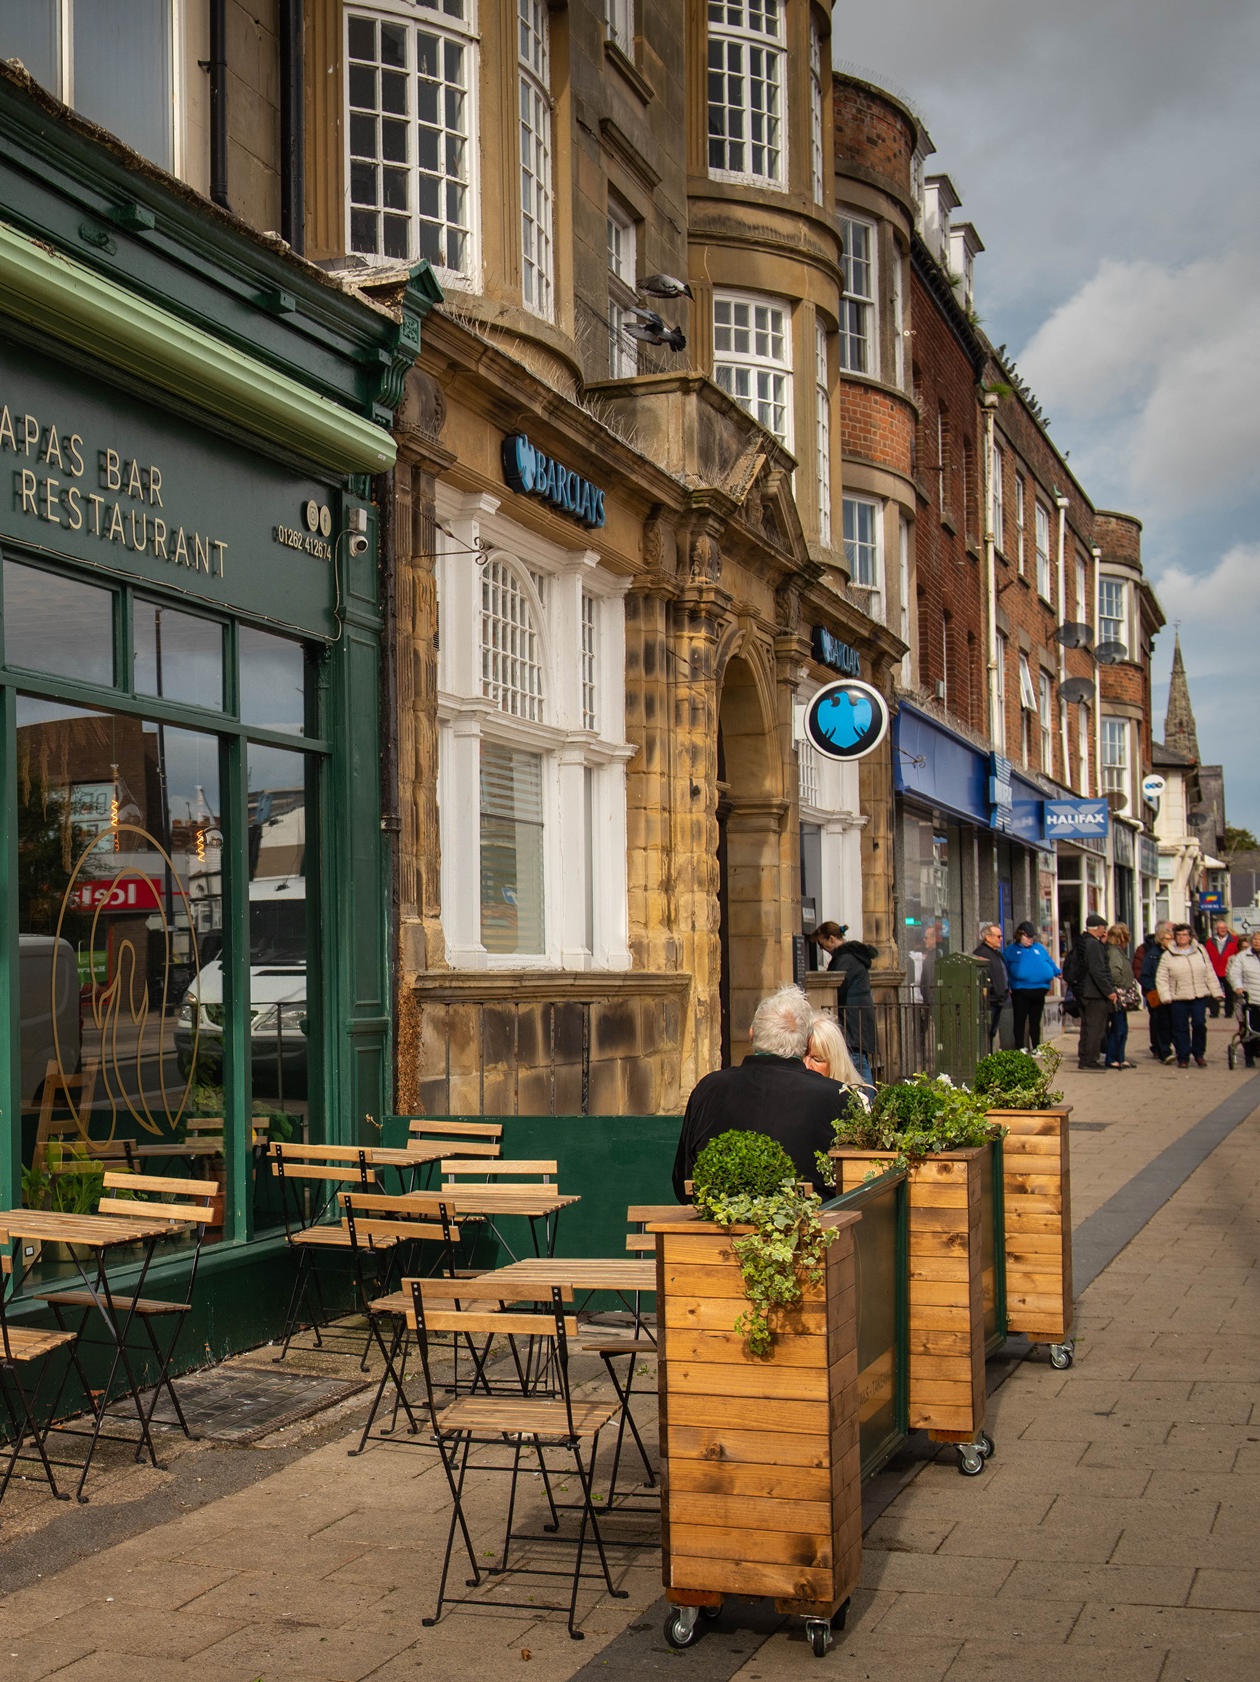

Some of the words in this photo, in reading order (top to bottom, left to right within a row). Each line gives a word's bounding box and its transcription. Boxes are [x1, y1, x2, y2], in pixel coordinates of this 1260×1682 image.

[106, 448, 164, 508] BAR
[535, 450, 606, 529] BARCLAYS
[21, 468, 230, 579] RESTAURANT
[278, 525, 303, 551] 01262
[305, 536, 332, 562] 412674
[1046, 813, 1105, 825] HALIFAX
